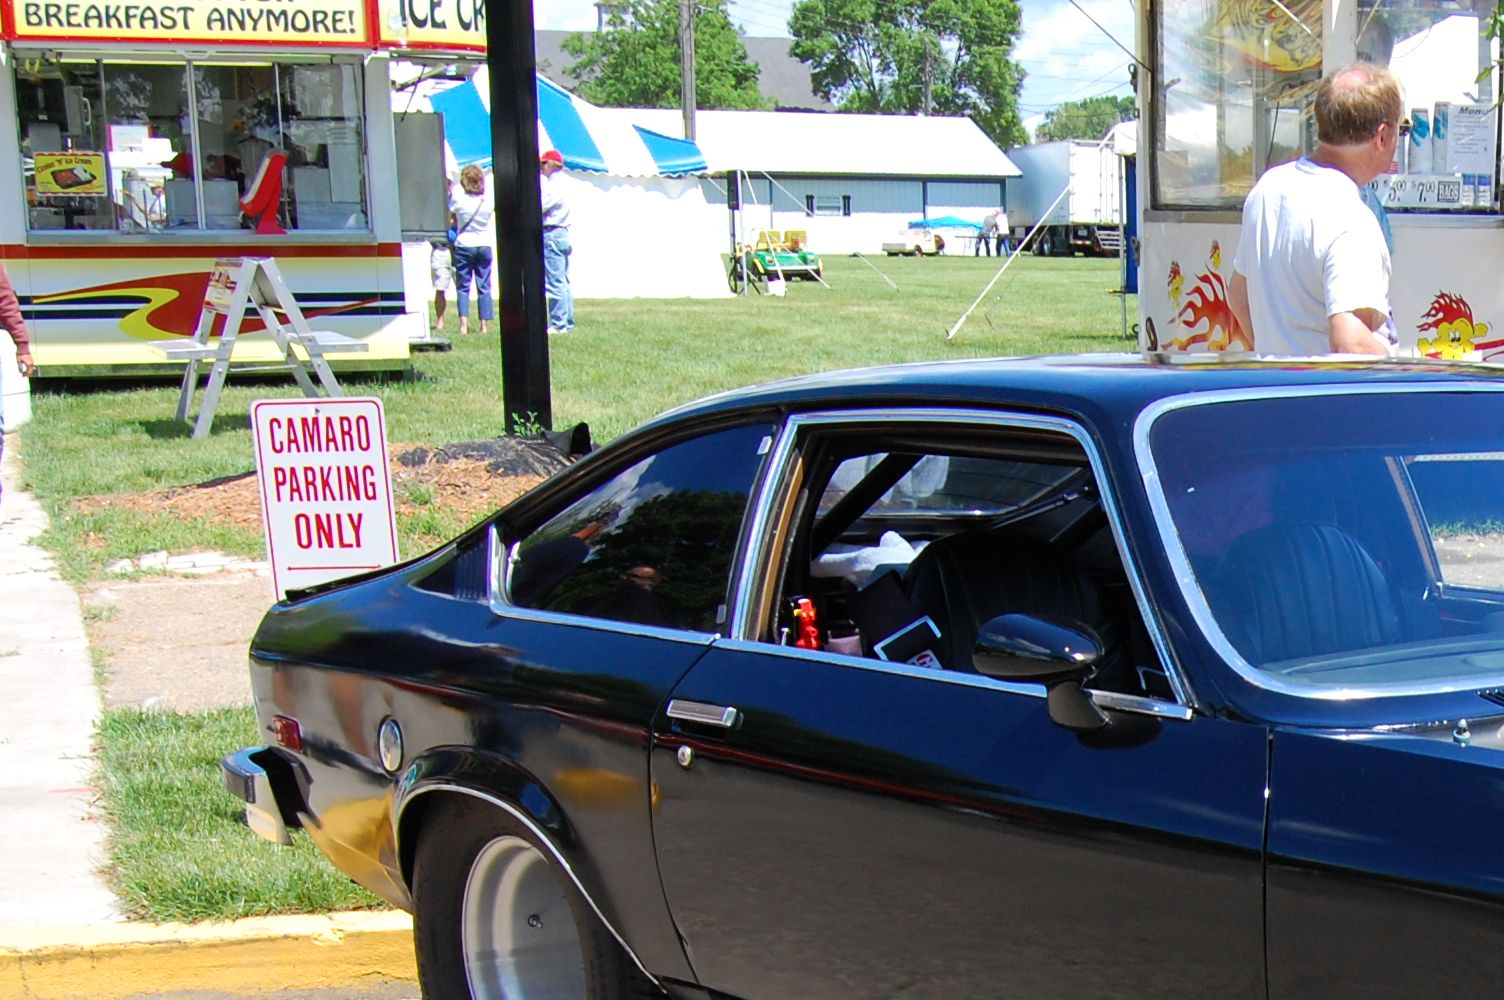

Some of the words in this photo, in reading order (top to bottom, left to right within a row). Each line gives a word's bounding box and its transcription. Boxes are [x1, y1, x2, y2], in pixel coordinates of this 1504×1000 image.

[24, 3, 195, 30] BREAKFAST
[206, 7, 356, 34] ANYMORE!
[400, 0, 447, 29] ICE
[1458, 106, 1488, 116] Menu
[269, 415, 371, 453] CAMARO
[273, 464, 377, 502] PARKING
[294, 512, 363, 549] ONLY
